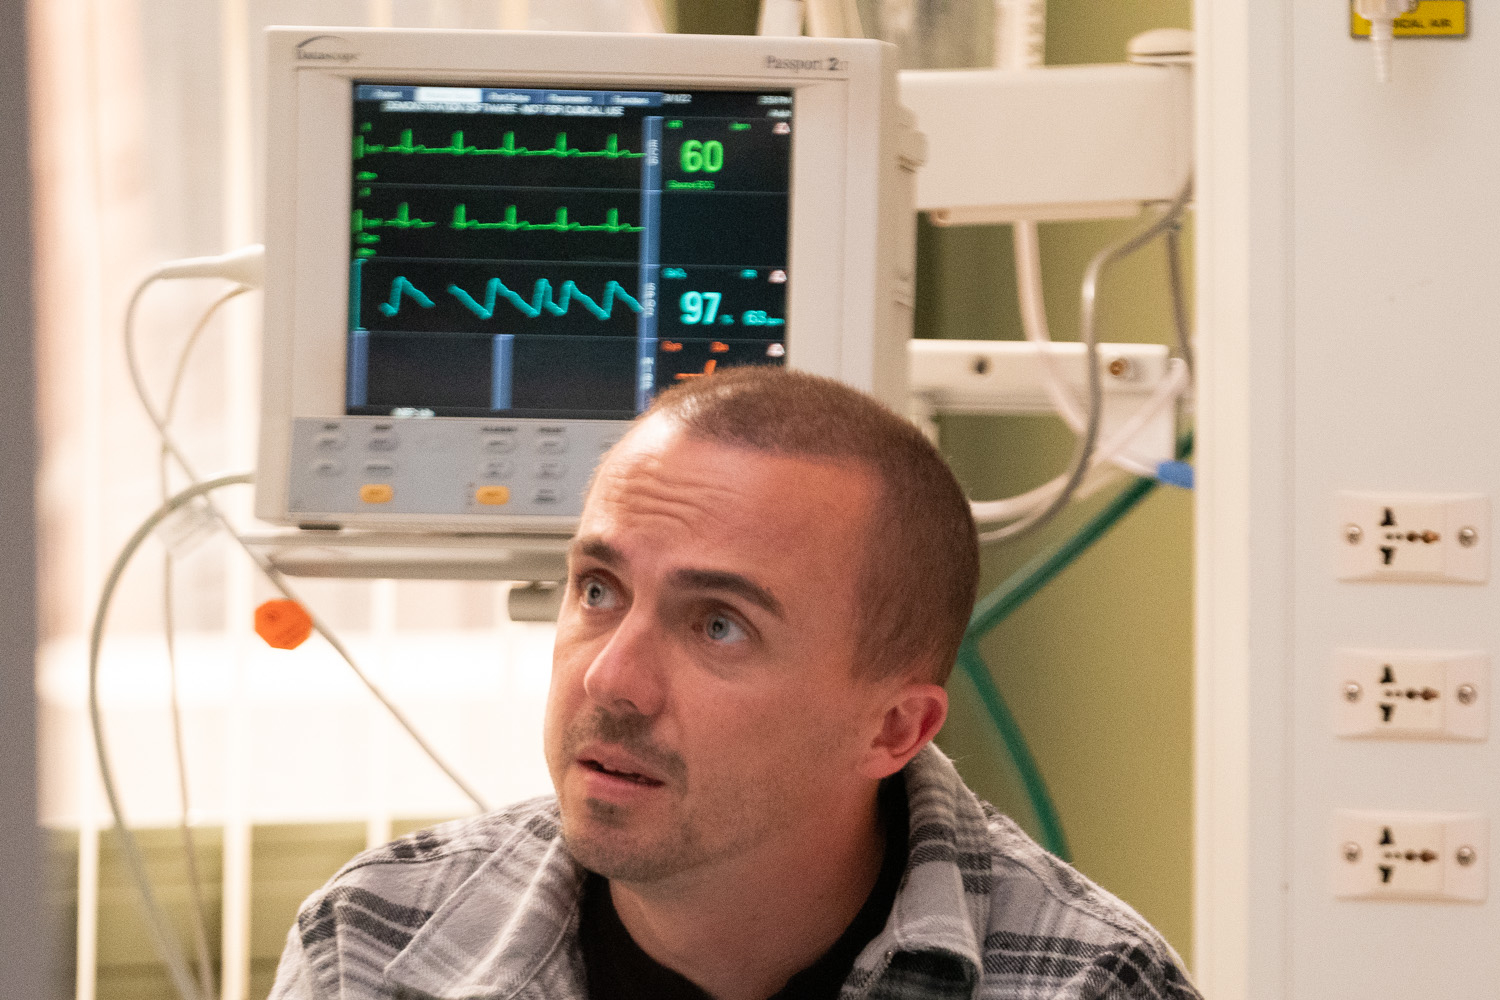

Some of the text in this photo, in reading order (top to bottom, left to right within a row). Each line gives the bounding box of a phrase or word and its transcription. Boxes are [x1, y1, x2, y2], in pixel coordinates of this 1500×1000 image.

[766, 55, 821, 73] Passport
[680, 139, 724, 173] 60
[680, 290, 722, 325] 97
